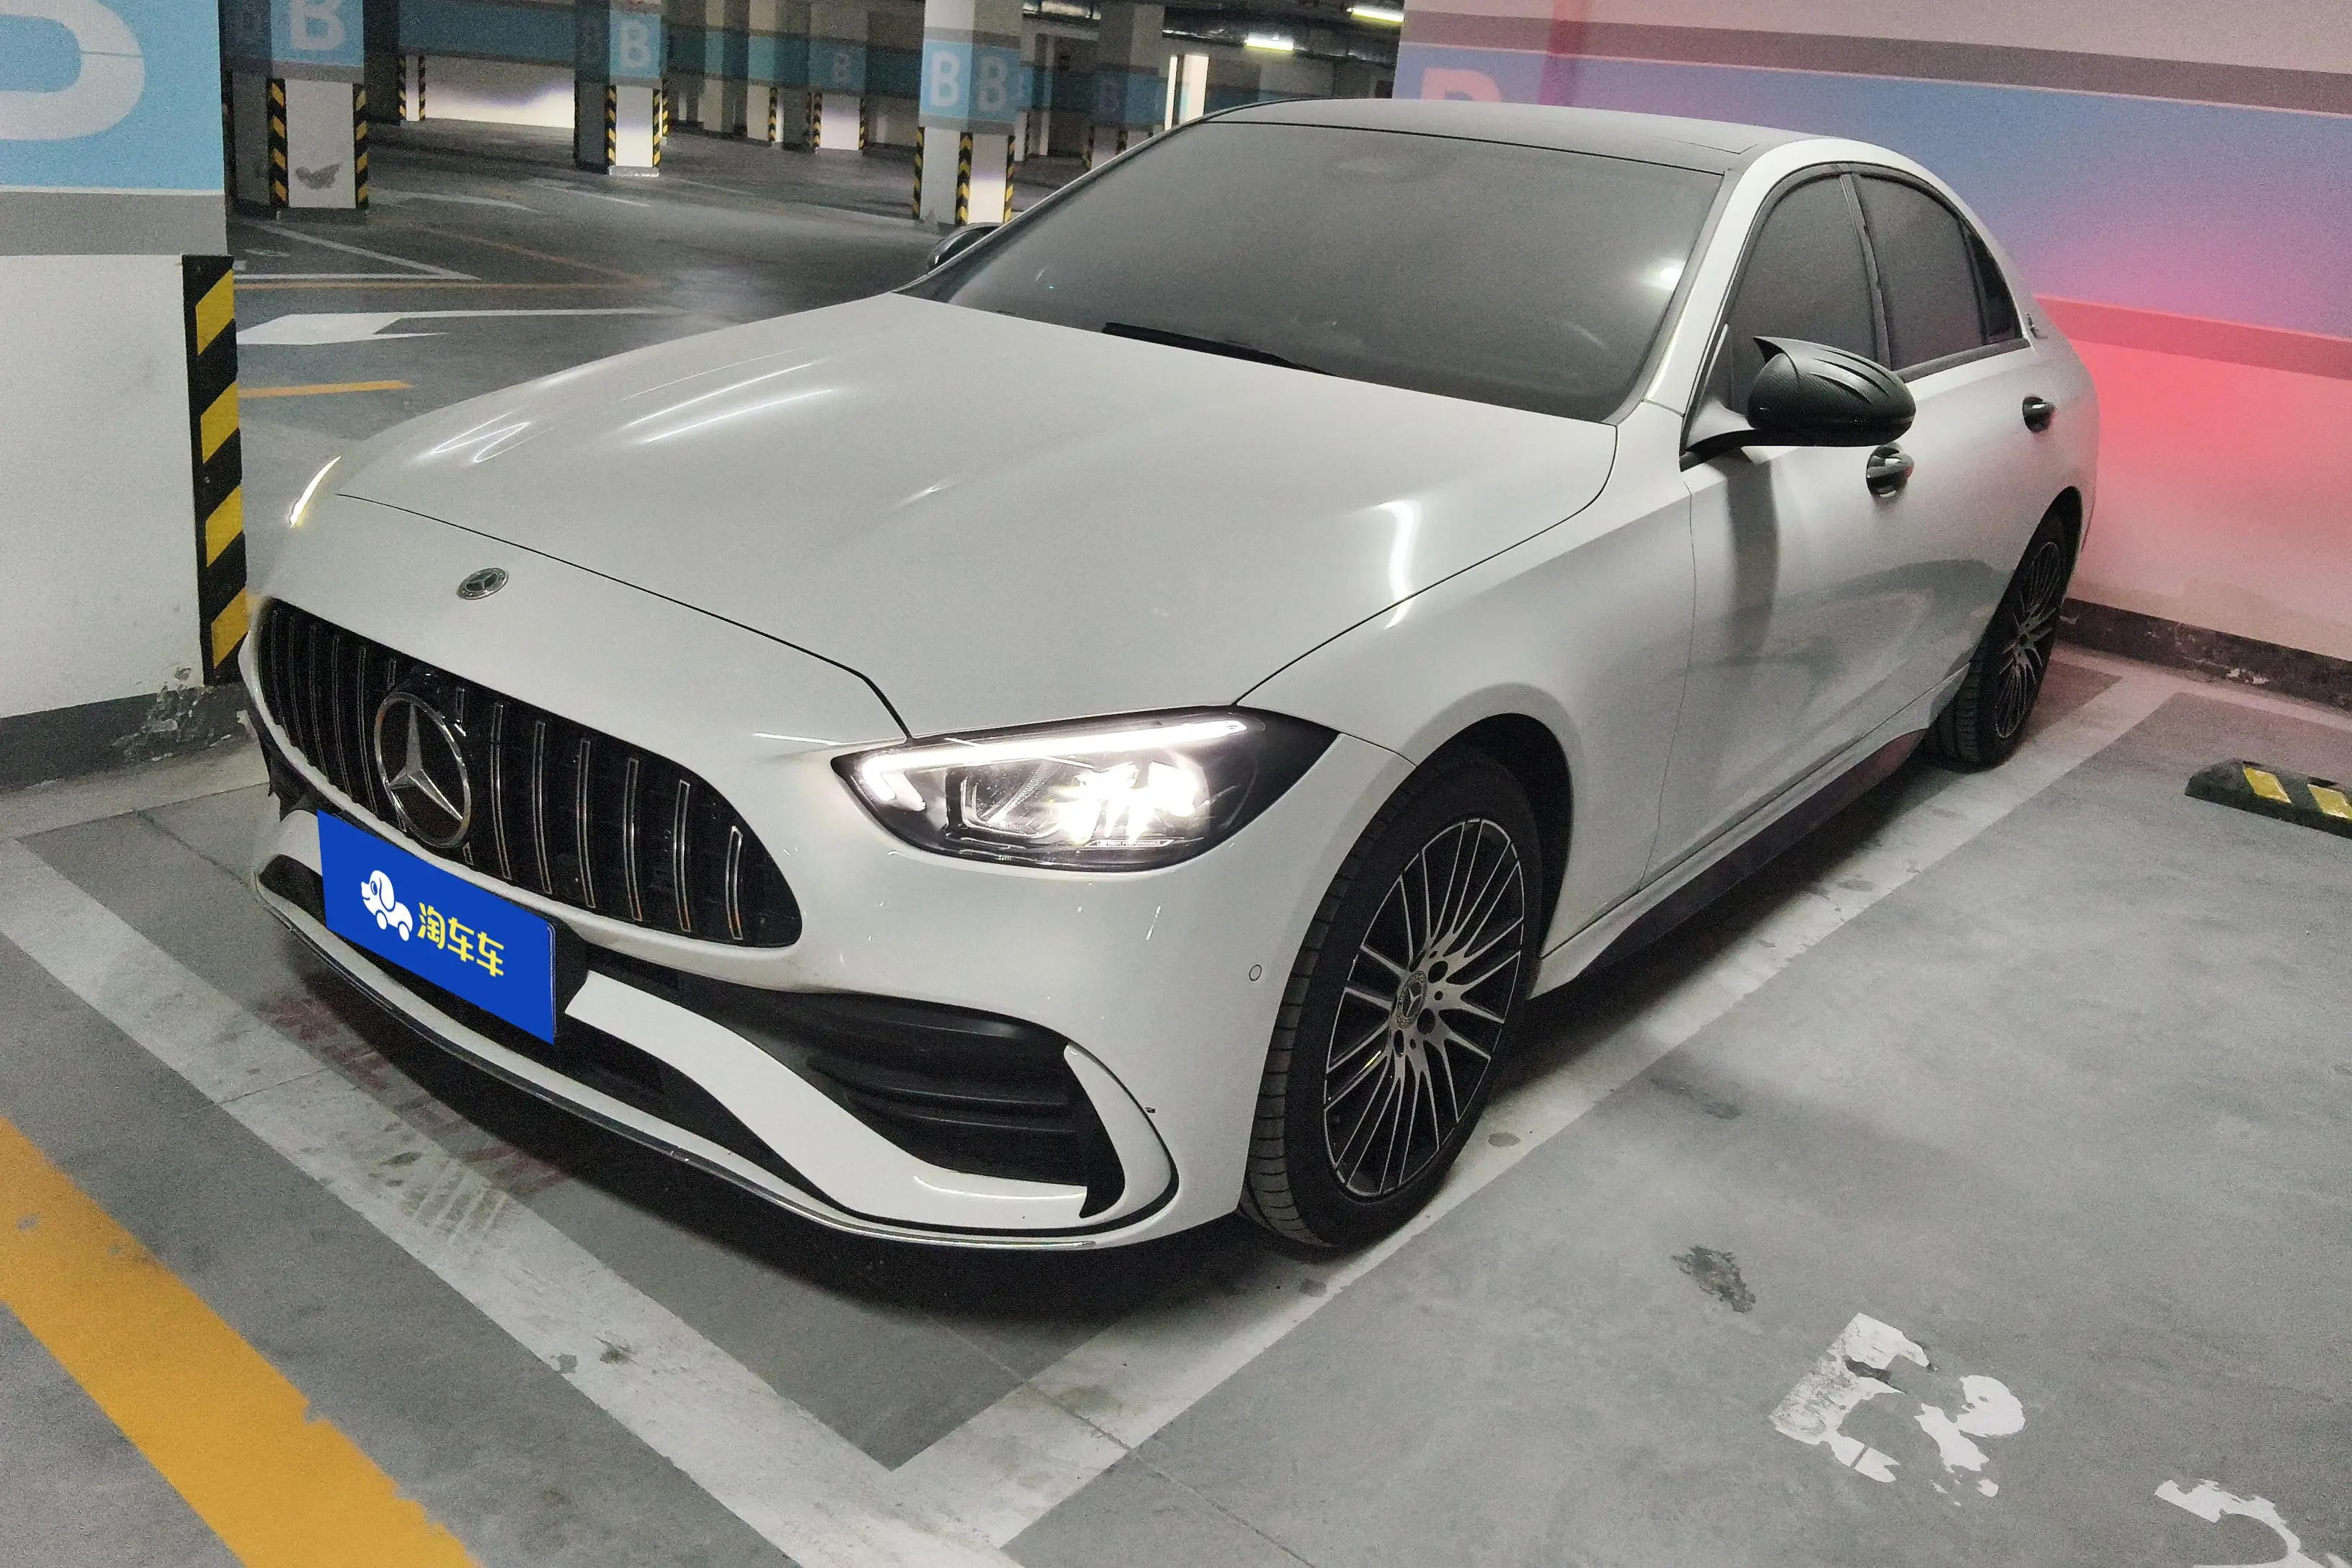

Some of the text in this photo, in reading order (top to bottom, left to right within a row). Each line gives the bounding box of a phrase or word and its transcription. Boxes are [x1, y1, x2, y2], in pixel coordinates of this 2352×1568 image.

[620, 20, 650, 68] B
[931, 50, 960, 107] B
[976, 55, 1007, 111] B
